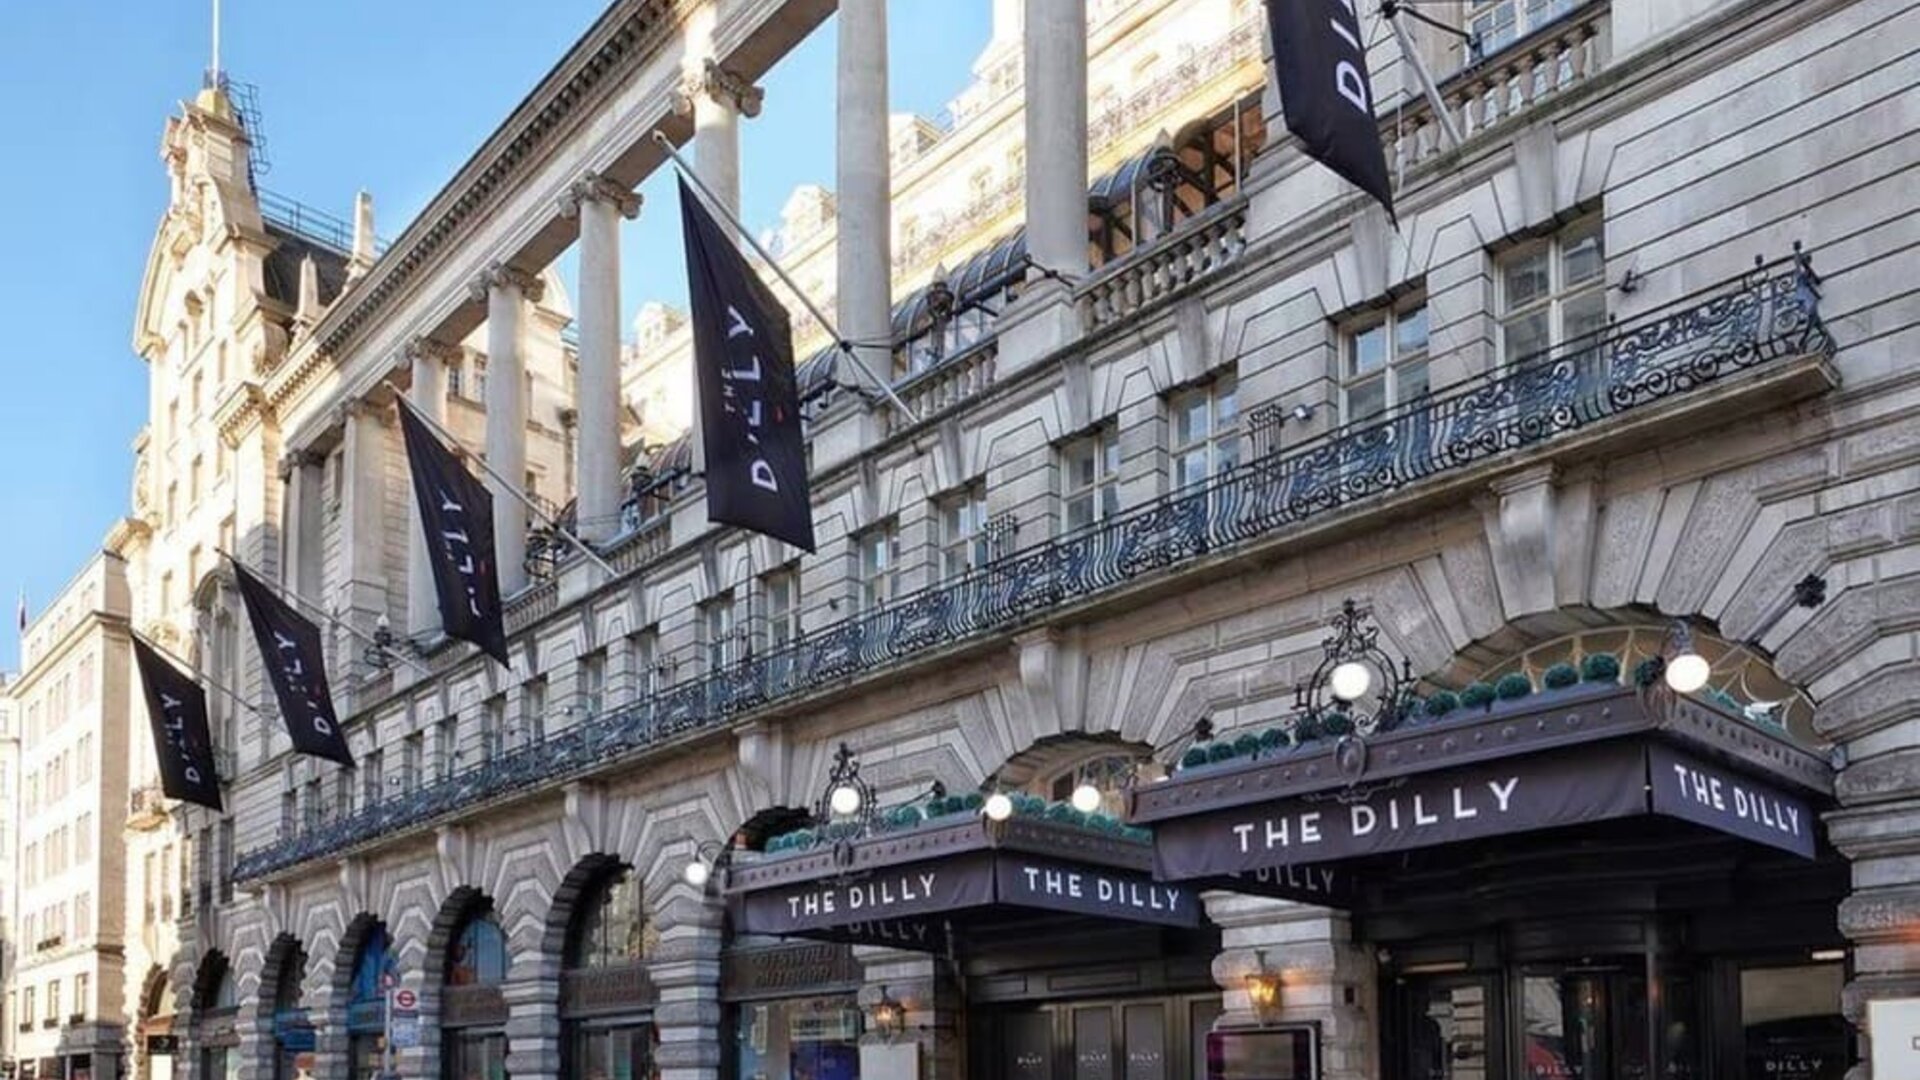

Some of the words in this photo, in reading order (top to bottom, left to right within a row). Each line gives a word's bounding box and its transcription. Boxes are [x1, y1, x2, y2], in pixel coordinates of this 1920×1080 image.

[1233, 811, 1324, 854] THE
[1351, 777, 1521, 837] DILLY
[1674, 764, 1725, 812] THE
[1733, 785, 1801, 837] DILLY
[788, 890, 835, 918] THE
[849, 873, 936, 909] DILLY
[1024, 867, 1082, 898] THE
[1098, 878, 1181, 912] DILLY
[1766, 1059, 1823, 1071] DILLY
